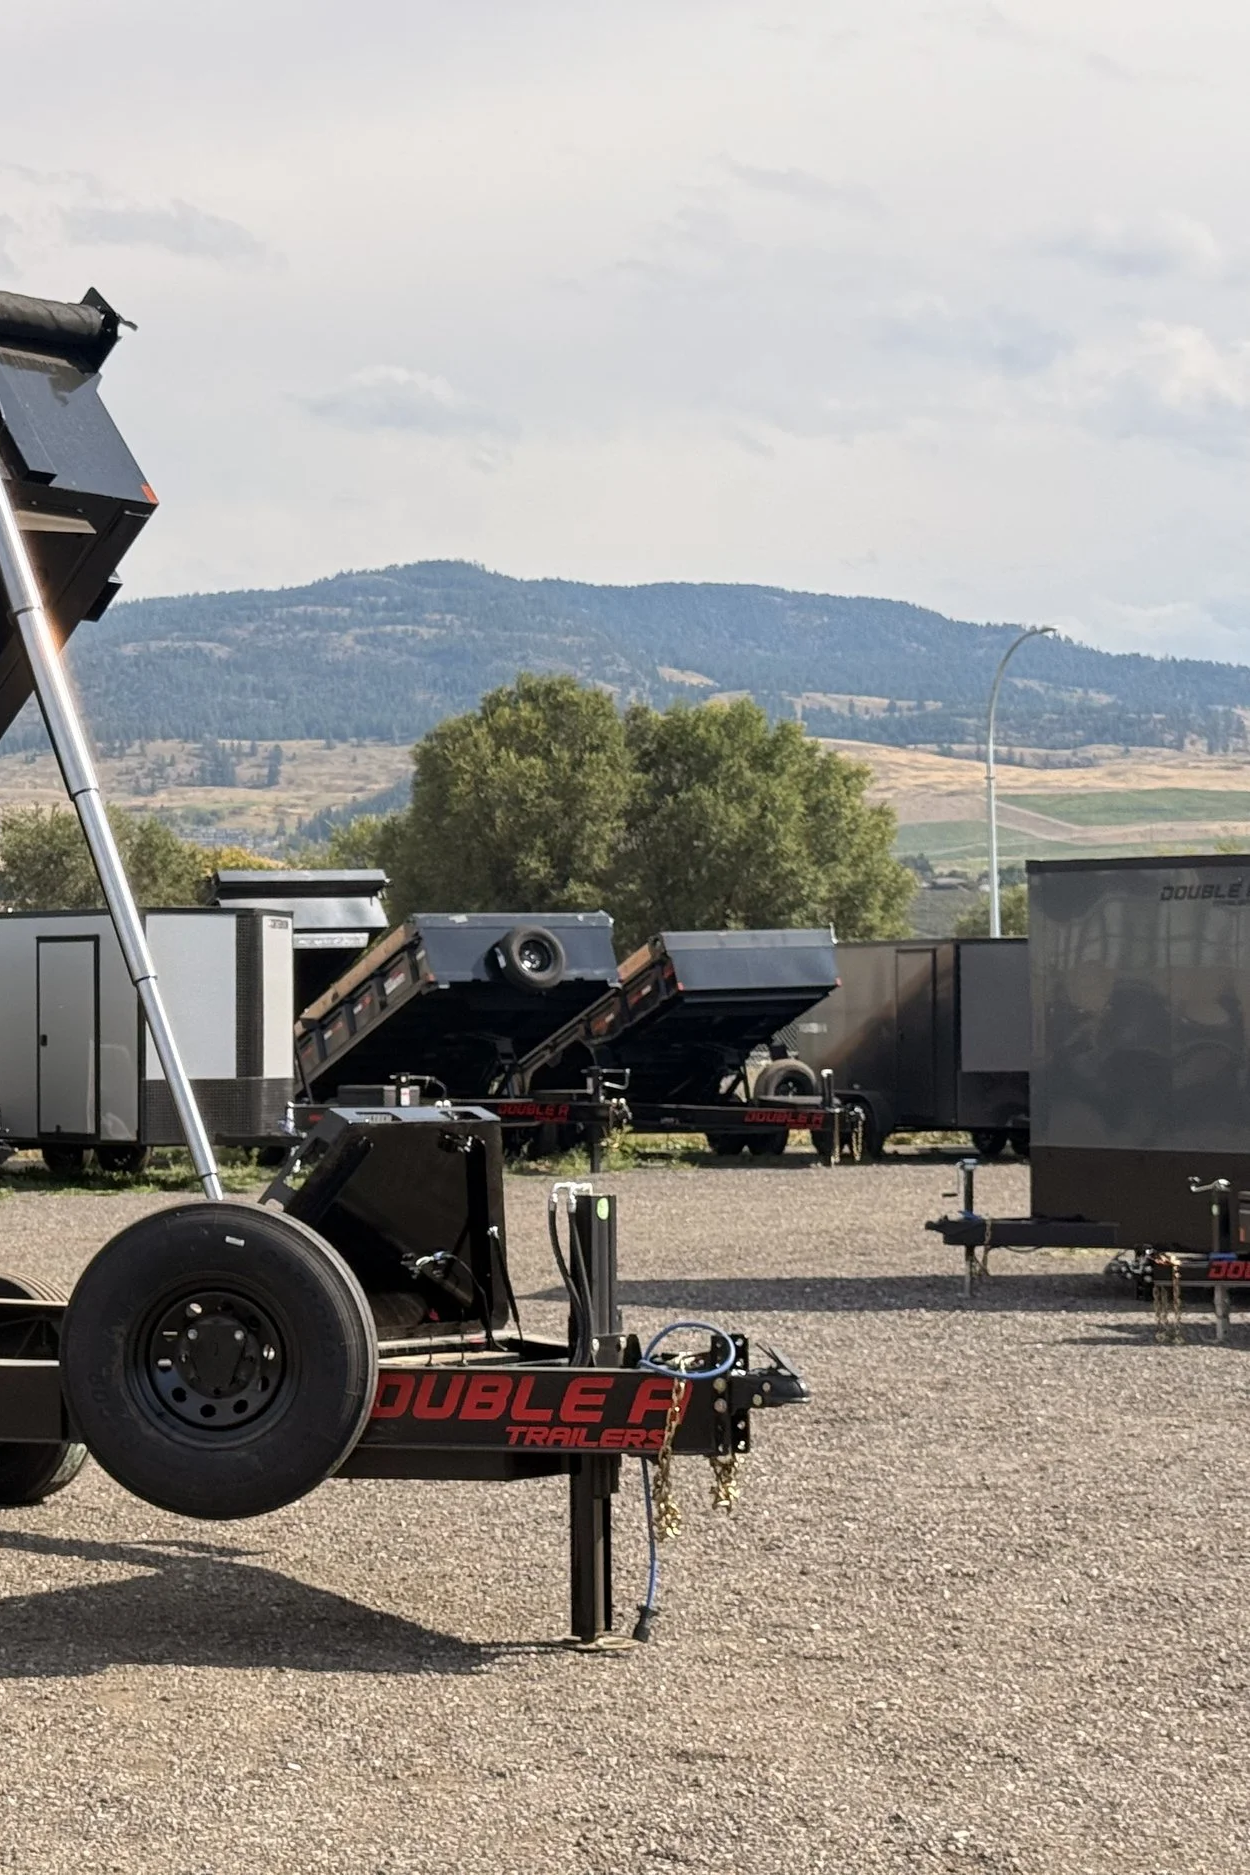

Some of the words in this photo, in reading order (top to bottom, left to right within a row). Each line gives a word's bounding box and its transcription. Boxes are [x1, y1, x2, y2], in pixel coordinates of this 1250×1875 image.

[1160, 883, 1243, 901] DOUBLE
[370, 1373, 615, 1423] DOUBLE
[627, 1376, 694, 1425] A
[505, 1426, 666, 1449] TRAILERS
